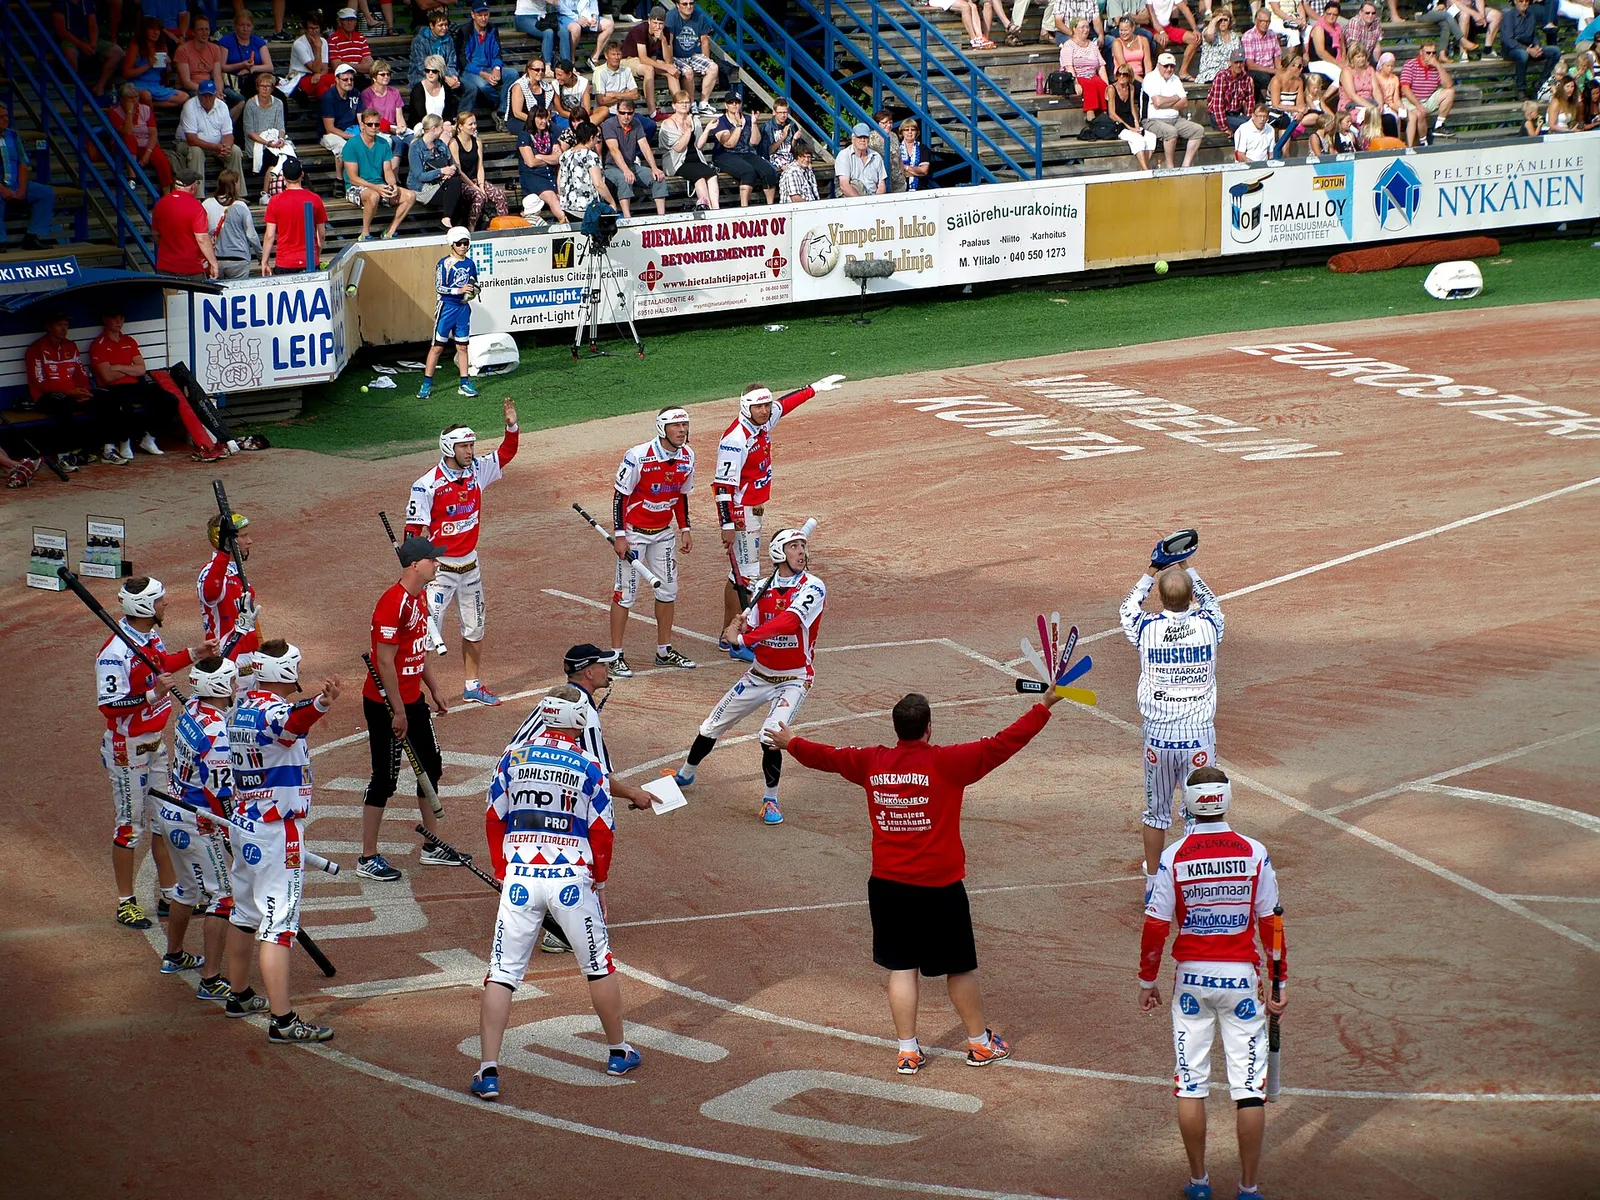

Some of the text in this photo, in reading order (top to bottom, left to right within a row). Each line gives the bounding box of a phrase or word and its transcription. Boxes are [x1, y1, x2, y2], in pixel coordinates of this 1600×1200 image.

[1433, 156, 1584, 180] PELTISEPÄNLIIKE
[1320, 177, 1345, 189] JOTUN
[1437, 174, 1584, 218] NYKÄNEN
[946, 201, 1078, 231] Säilörehu-urakointia
[1325, 199, 1347, 217] OY
[641, 217, 787, 249] HIETALAHTI JA POJAT OY
[828, 215, 937, 248] Vimpelin lukio
[1269, 218, 1345, 234] TEOLLISUUSMAALIT
[1268, 229, 1330, 243] JA PINNOITTEET
[494, 246, 548, 258] AUTROSAFE OY
[661, 244, 766, 267] BETONIELEMENTIT
[959, 247, 1067, 268] M. Ylitalo 040 550 1273
[16, 262, 75, 280] TRAVELS
[478, 276, 524, 288] aarikentän
[526, 271, 565, 285] valaistus
[600, 269, 629, 280] edeillä
[662, 271, 767, 289] www.hietalahtijapojat.fi
[637, 296, 687, 307] HIETALAHDENTIE
[655, 306, 678, 315] HALSUA
[510, 309, 575, 326] Arrant-Light
[1010, 374, 1343, 462] VIMPELIN
[896, 394, 1145, 462] KUNTA
[618, 467, 627, 481] 4
[723, 461, 732, 477] 7
[408, 500, 417, 516] 5
[801, 594, 815, 611] 2
[1147, 643, 1212, 664] HUUSKONEN
[1155, 666, 1208, 675] NELIMARKAN
[1170, 674, 1208, 684] LEIPOMO
[105, 674, 118, 693] 3
[1150, 738, 1202, 750] ILKKA
[531, 750, 581, 768] RAUTIA
[210, 767, 232, 788] 12
[242, 774, 262, 786] PRO
[518, 768, 580, 788] DAHLSTRÖM
[511, 789, 554, 809] ymp
[1195, 793, 1224, 804] AVANT
[544, 816, 569, 830] PRO
[513, 865, 577, 879] ILKKA
[1187, 860, 1247, 878] KATAJISTO
[1182, 884, 1250, 902] pohjanmaan
[1182, 973, 1250, 989] ILKKA
